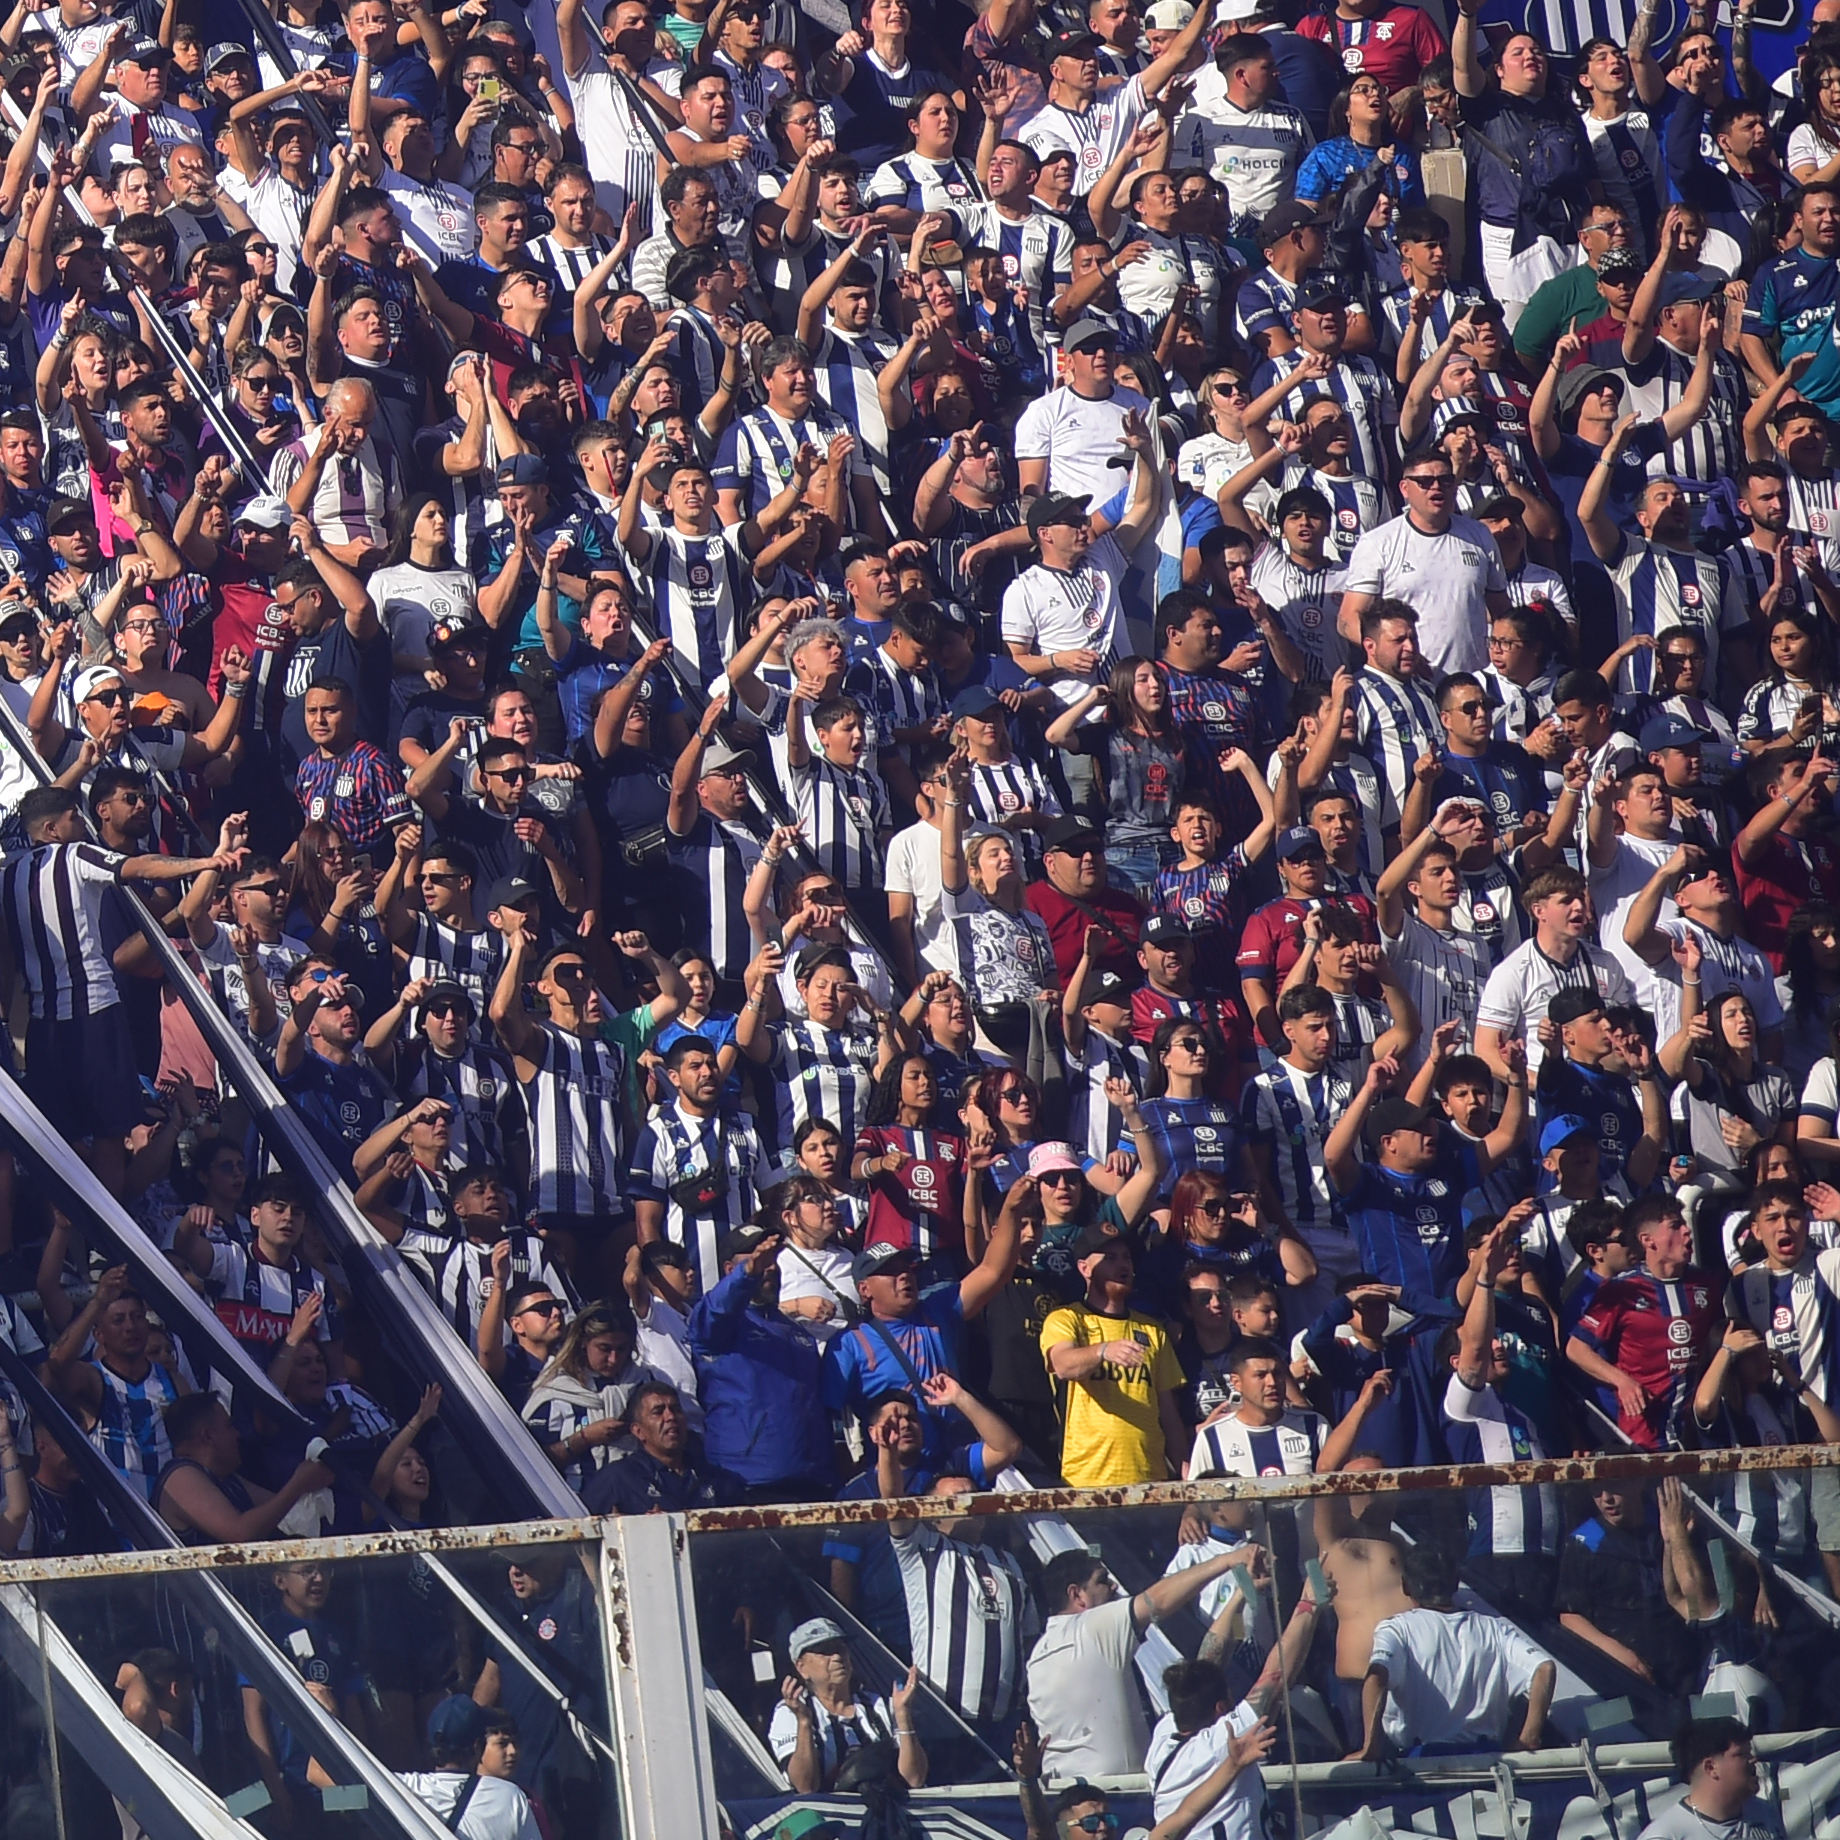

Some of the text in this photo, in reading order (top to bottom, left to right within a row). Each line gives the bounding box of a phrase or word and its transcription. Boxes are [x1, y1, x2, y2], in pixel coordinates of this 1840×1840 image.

[949, 195, 976, 205] ICBC
[1497, 421, 1525, 432] ICBC
[689, 587, 714, 598] ICBC
[257, 624, 286, 637] ICBC
[1203, 722, 1234, 733] ICBC
[823, 1062, 866, 1075] HOLC
[1195, 1142, 1224, 1152] ICBC
[907, 1187, 938, 1199] ICBC
[1667, 1347, 1696, 1358] ICBC
